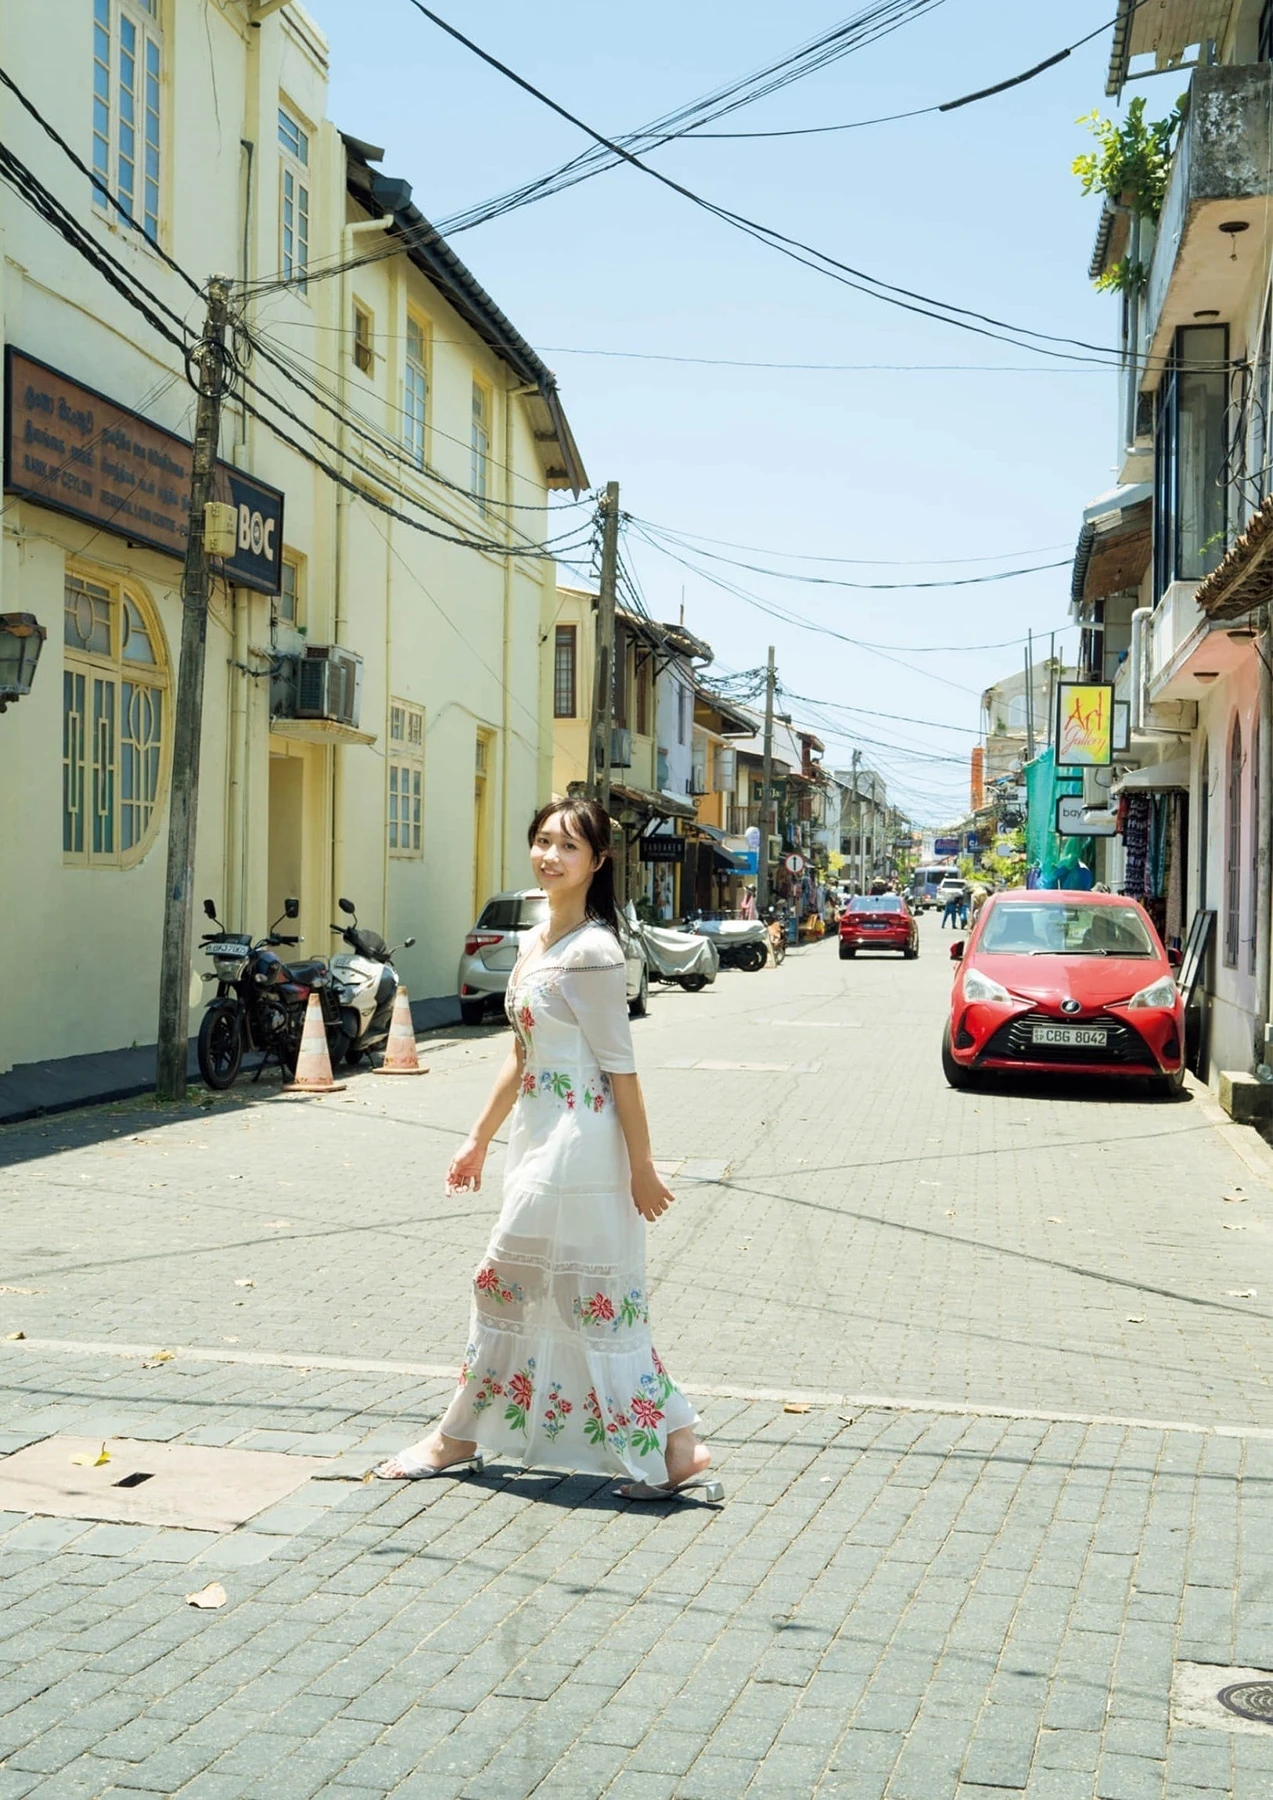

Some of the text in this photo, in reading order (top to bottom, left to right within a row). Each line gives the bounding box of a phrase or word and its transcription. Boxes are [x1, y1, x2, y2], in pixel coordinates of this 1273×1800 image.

[238, 503, 275, 561] BOC
[1064, 691, 1103, 731] Art
[1061, 724, 1106, 756] Gallery
[1046, 1030, 1106, 1045] CBG 8042
